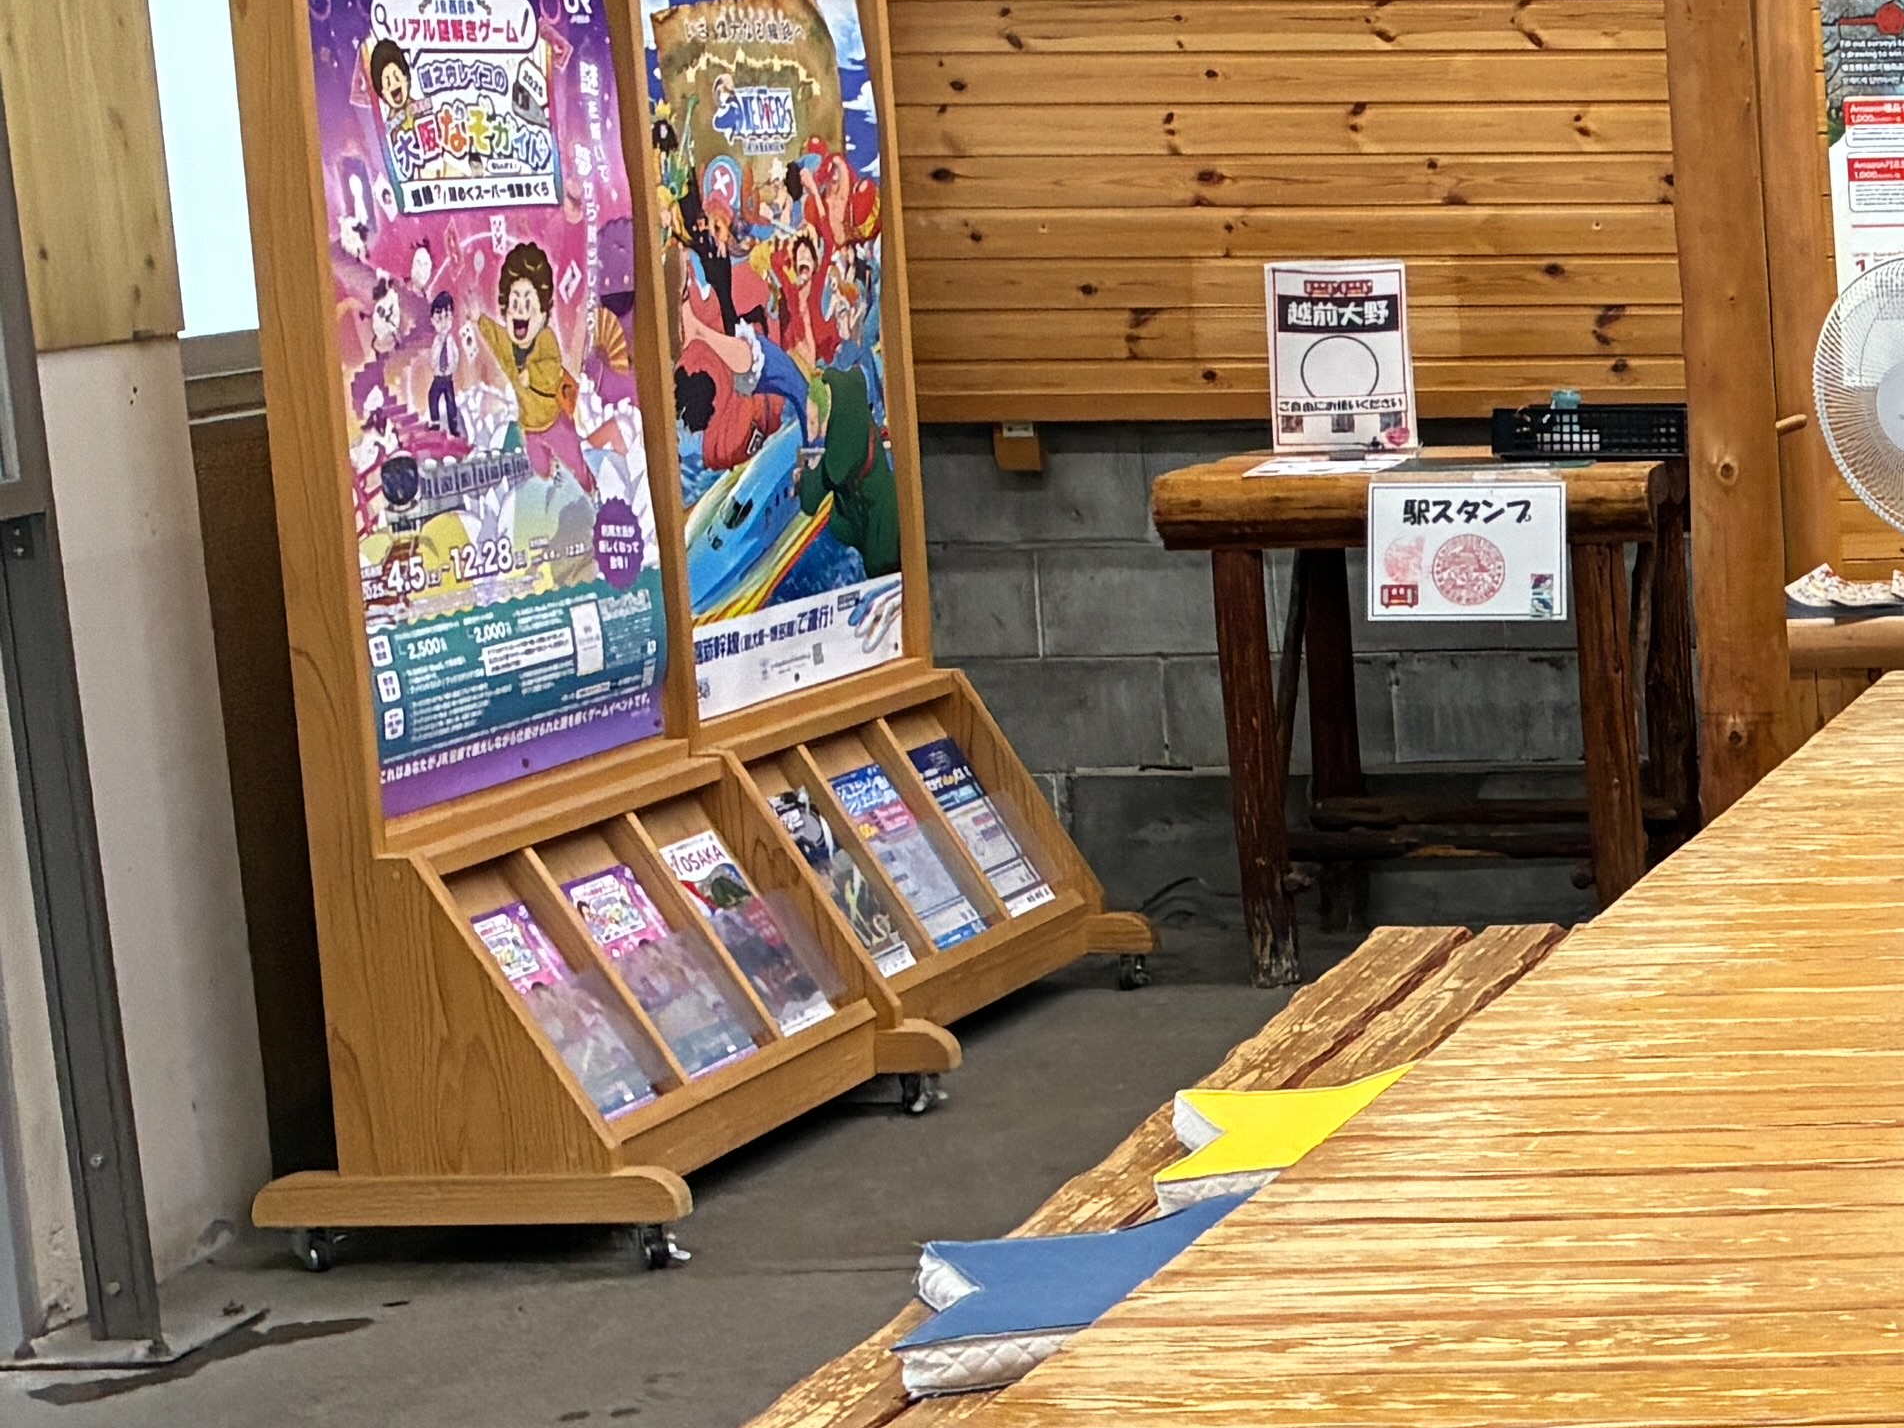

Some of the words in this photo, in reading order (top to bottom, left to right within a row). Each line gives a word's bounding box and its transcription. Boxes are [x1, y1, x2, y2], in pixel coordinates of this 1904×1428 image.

[1287, 300, 1390, 328] 越前大野
[1402, 499, 1533, 526] 駅スタンプ
[387, 556, 427, 591] 4.5
[452, 538, 514, 580] 12.28
[680, 844, 725, 874] OSAKA
